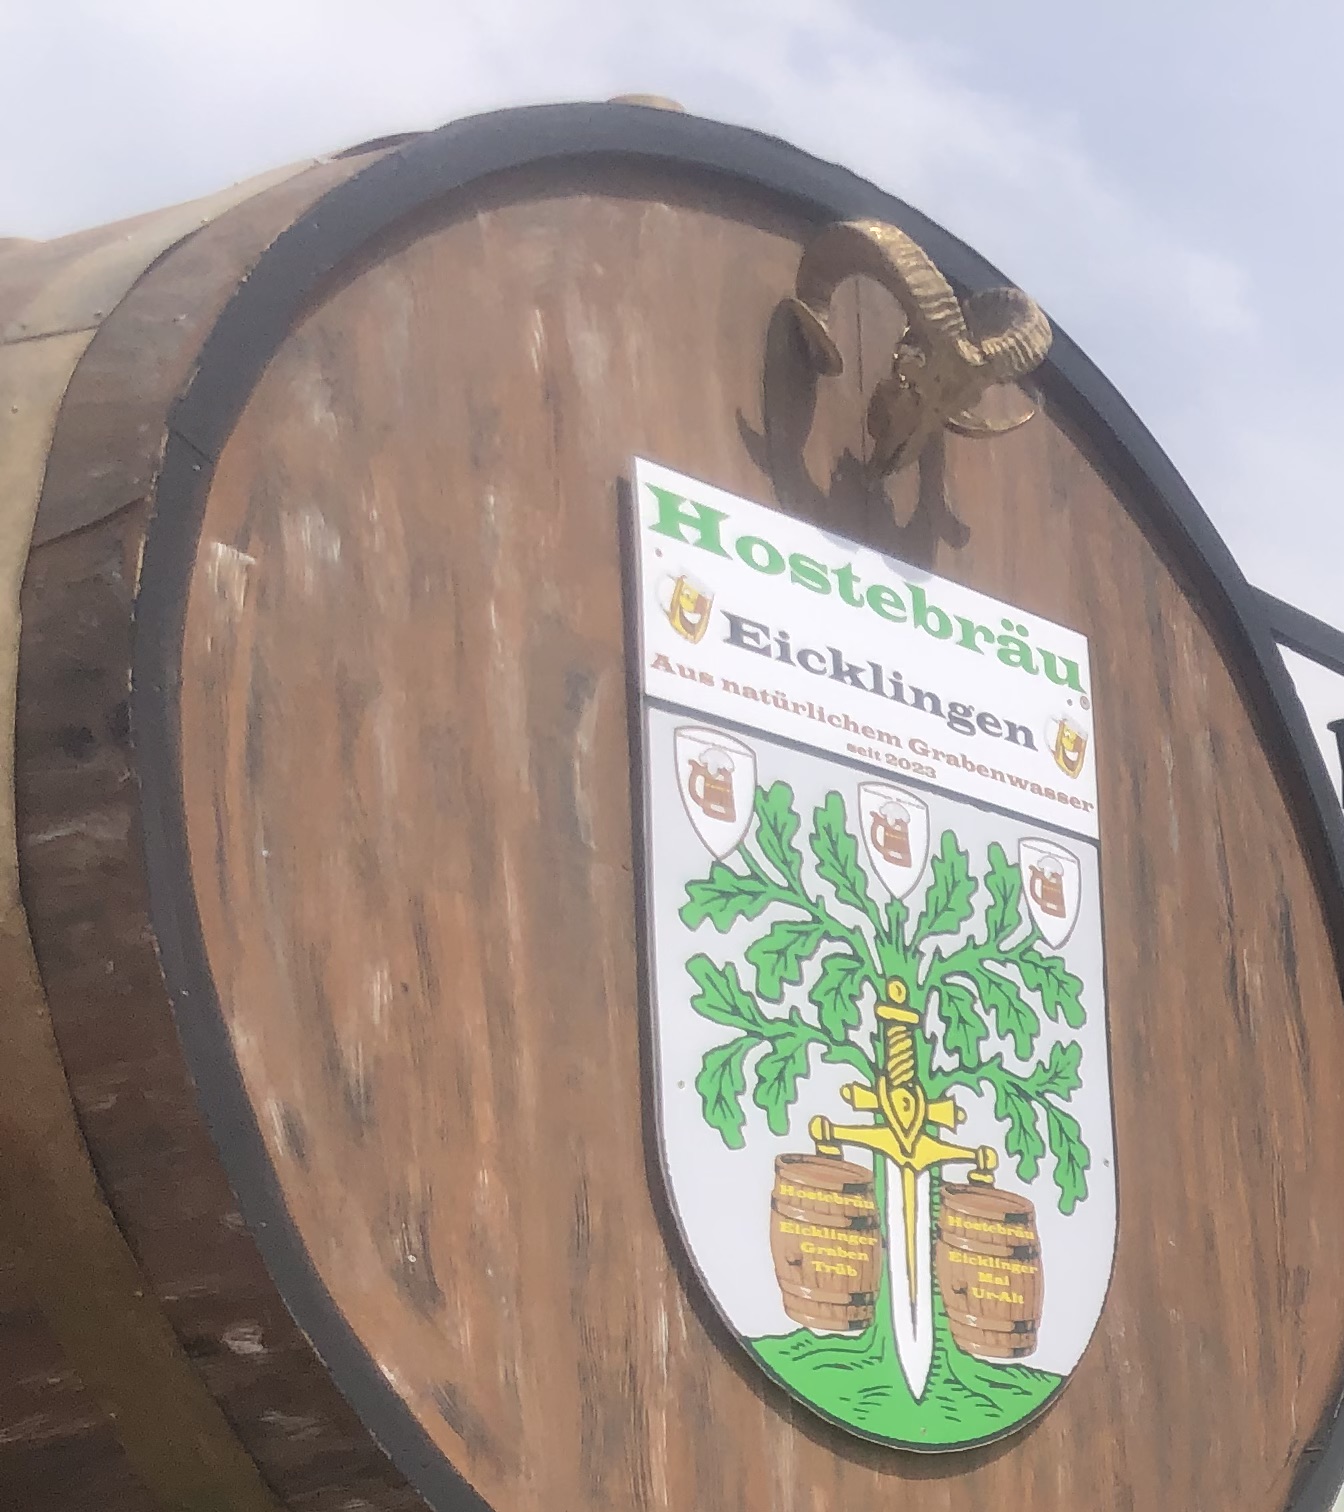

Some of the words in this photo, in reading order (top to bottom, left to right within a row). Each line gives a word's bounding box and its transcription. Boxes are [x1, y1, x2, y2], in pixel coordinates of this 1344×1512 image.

[645, 482, 1087, 693] Hostebräu
[719, 610, 1038, 752] Eicklingen
[650, 653, 715, 687] Aus
[721, 679, 902, 749] natürlichem
[908, 738, 1094, 812] Grabenwasser
[847, 743, 881, 760] seit
[885, 753, 937, 779] 2023
[779, 1184, 876, 1210] Hostebräu
[800, 1241, 869, 1261] Graben
